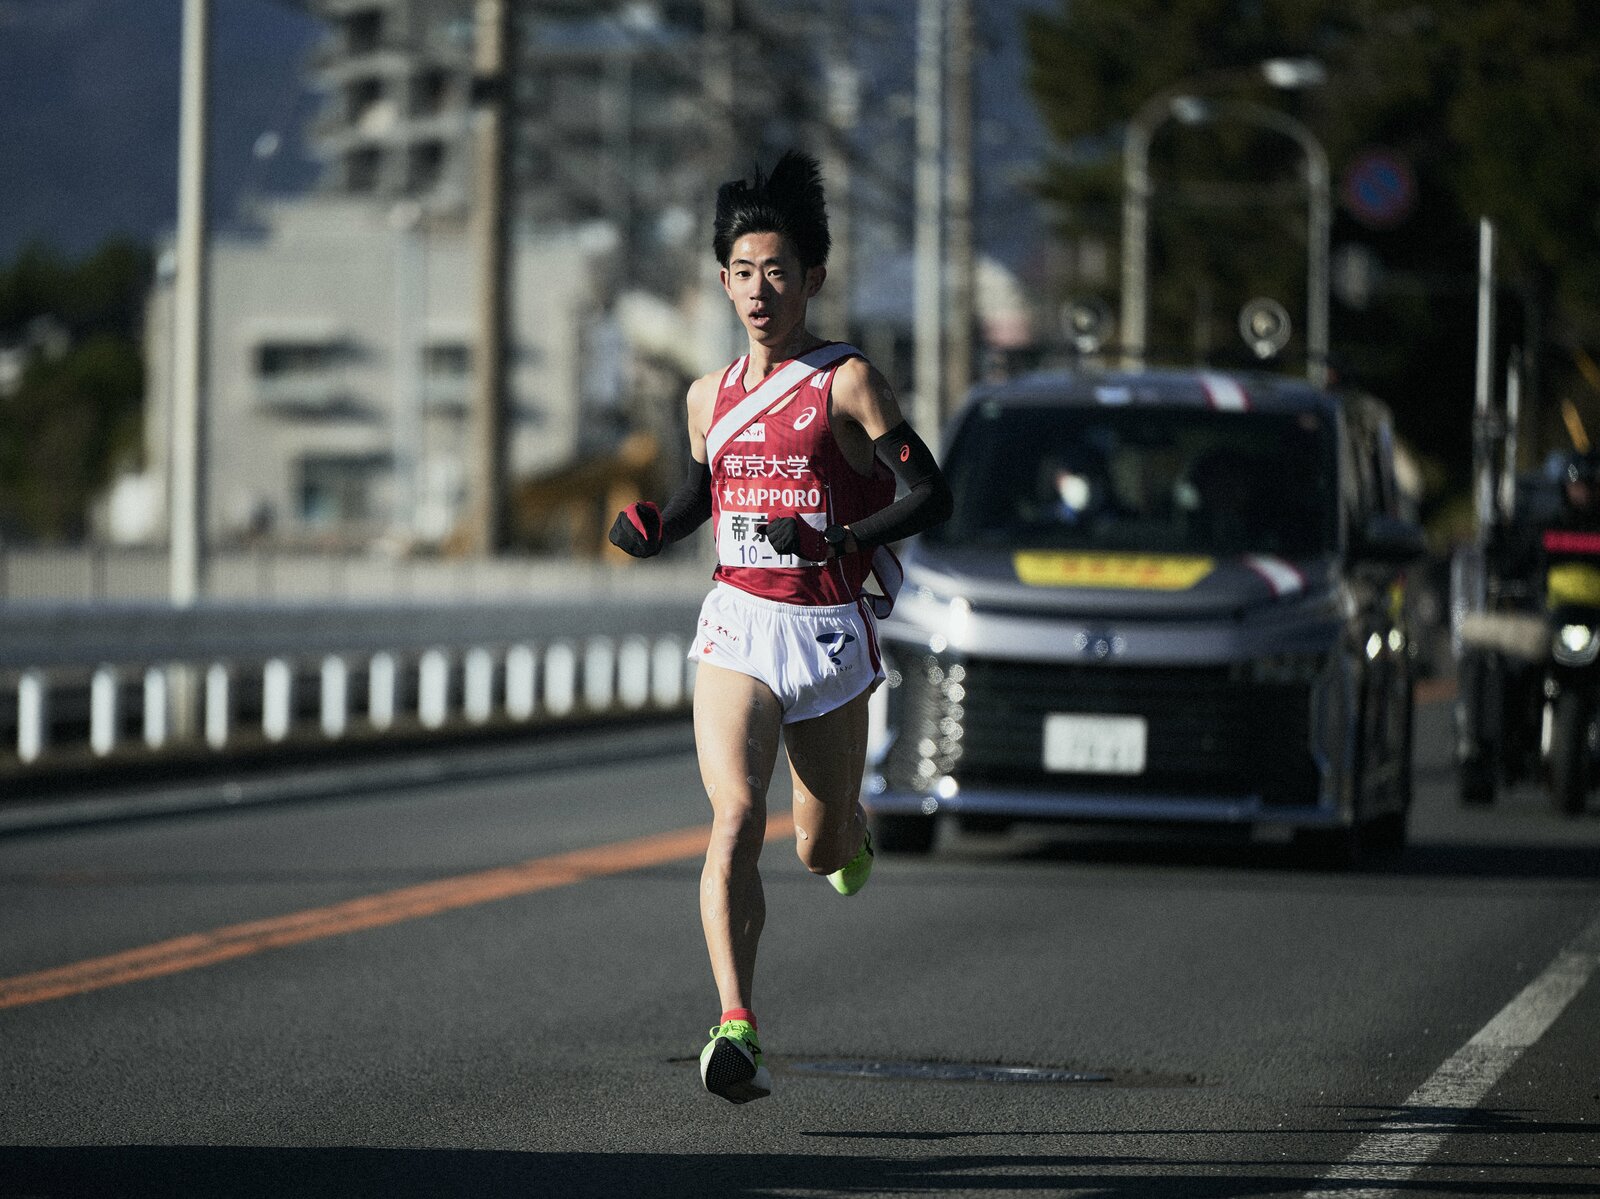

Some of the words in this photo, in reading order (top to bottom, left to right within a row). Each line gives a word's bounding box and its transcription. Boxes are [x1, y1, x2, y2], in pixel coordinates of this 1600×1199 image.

[723, 453, 811, 480] 帝京大学
[736, 487, 821, 508] SAPPORO
